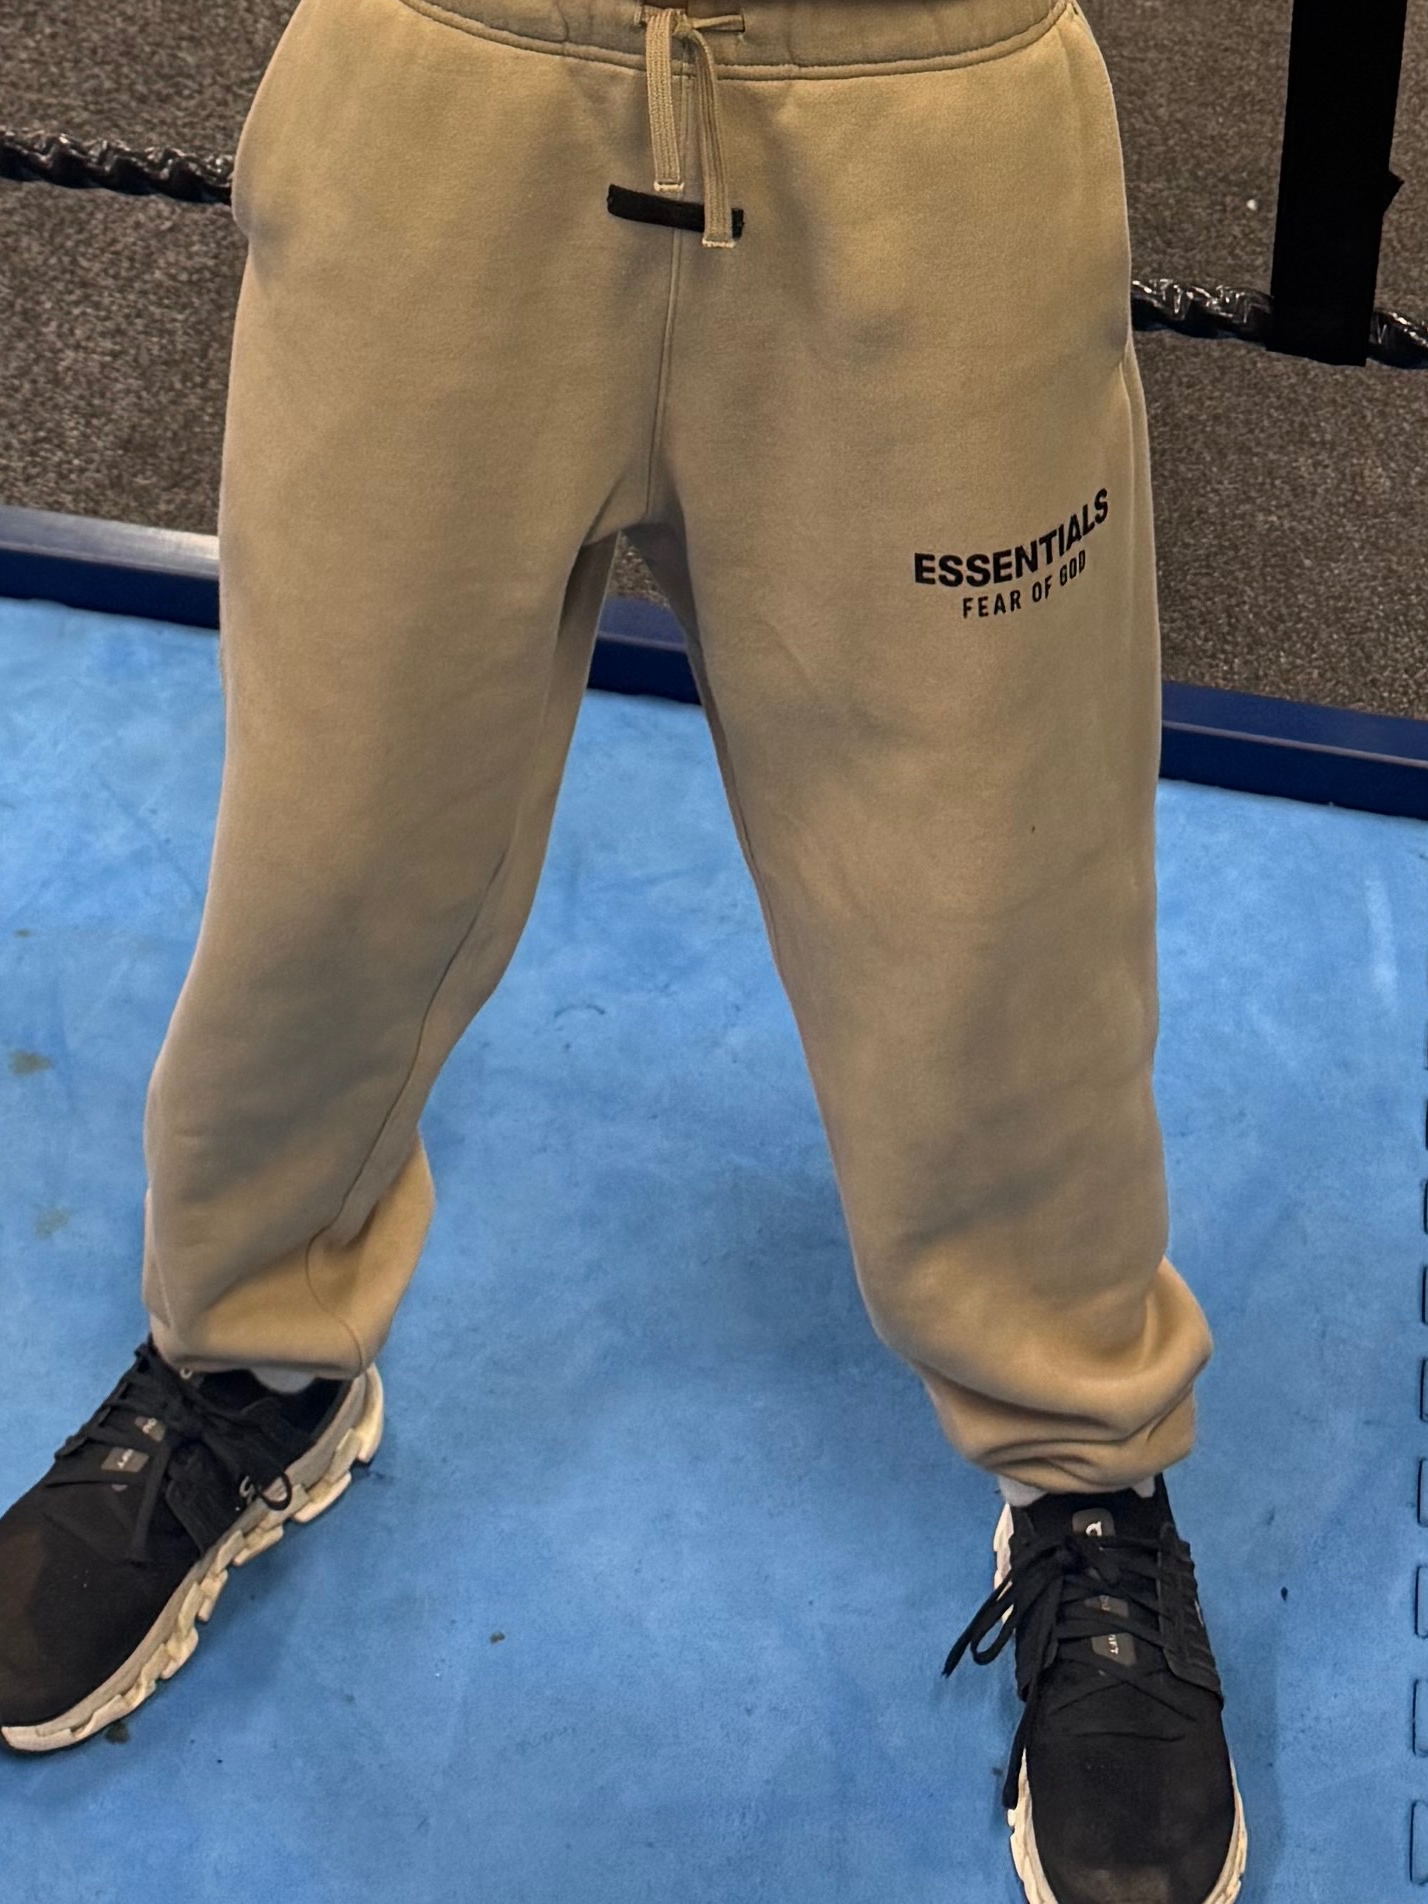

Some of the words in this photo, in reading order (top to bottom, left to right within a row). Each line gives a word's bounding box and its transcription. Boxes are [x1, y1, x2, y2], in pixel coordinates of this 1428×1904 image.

[913, 488, 1109, 588] ESSENTIALS
[962, 588, 1022, 619] FEAR
[1032, 575, 1054, 603] OF
[1059, 549, 1087, 588] GOD
